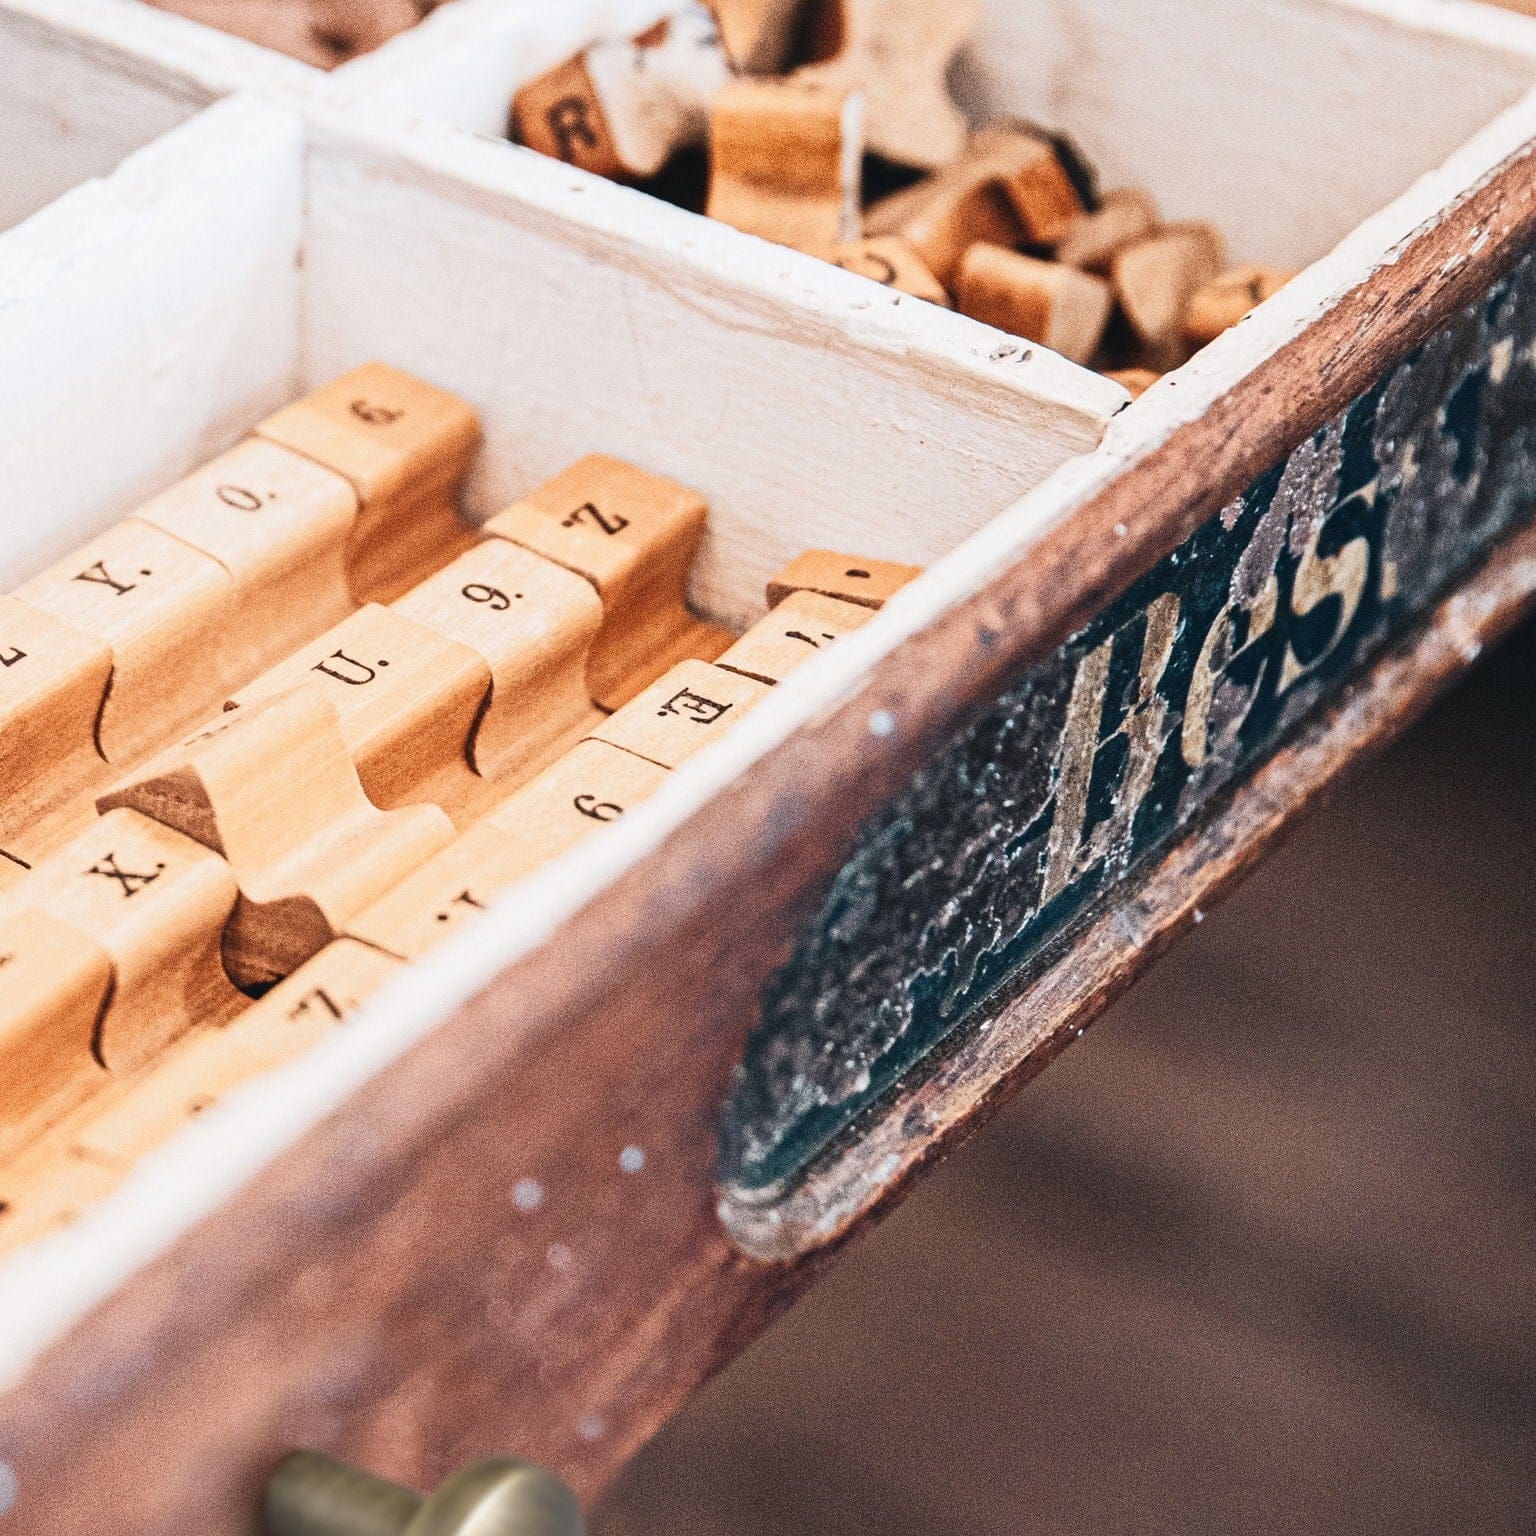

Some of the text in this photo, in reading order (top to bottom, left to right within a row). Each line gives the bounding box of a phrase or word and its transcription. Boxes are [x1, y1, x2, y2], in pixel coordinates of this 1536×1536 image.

[70, 561, 152, 596] Y.
[461, 583, 524, 611] 9.
[310, 649, 390, 686] U.
[656, 687, 734, 725] E.
[84, 853, 166, 898] X.
